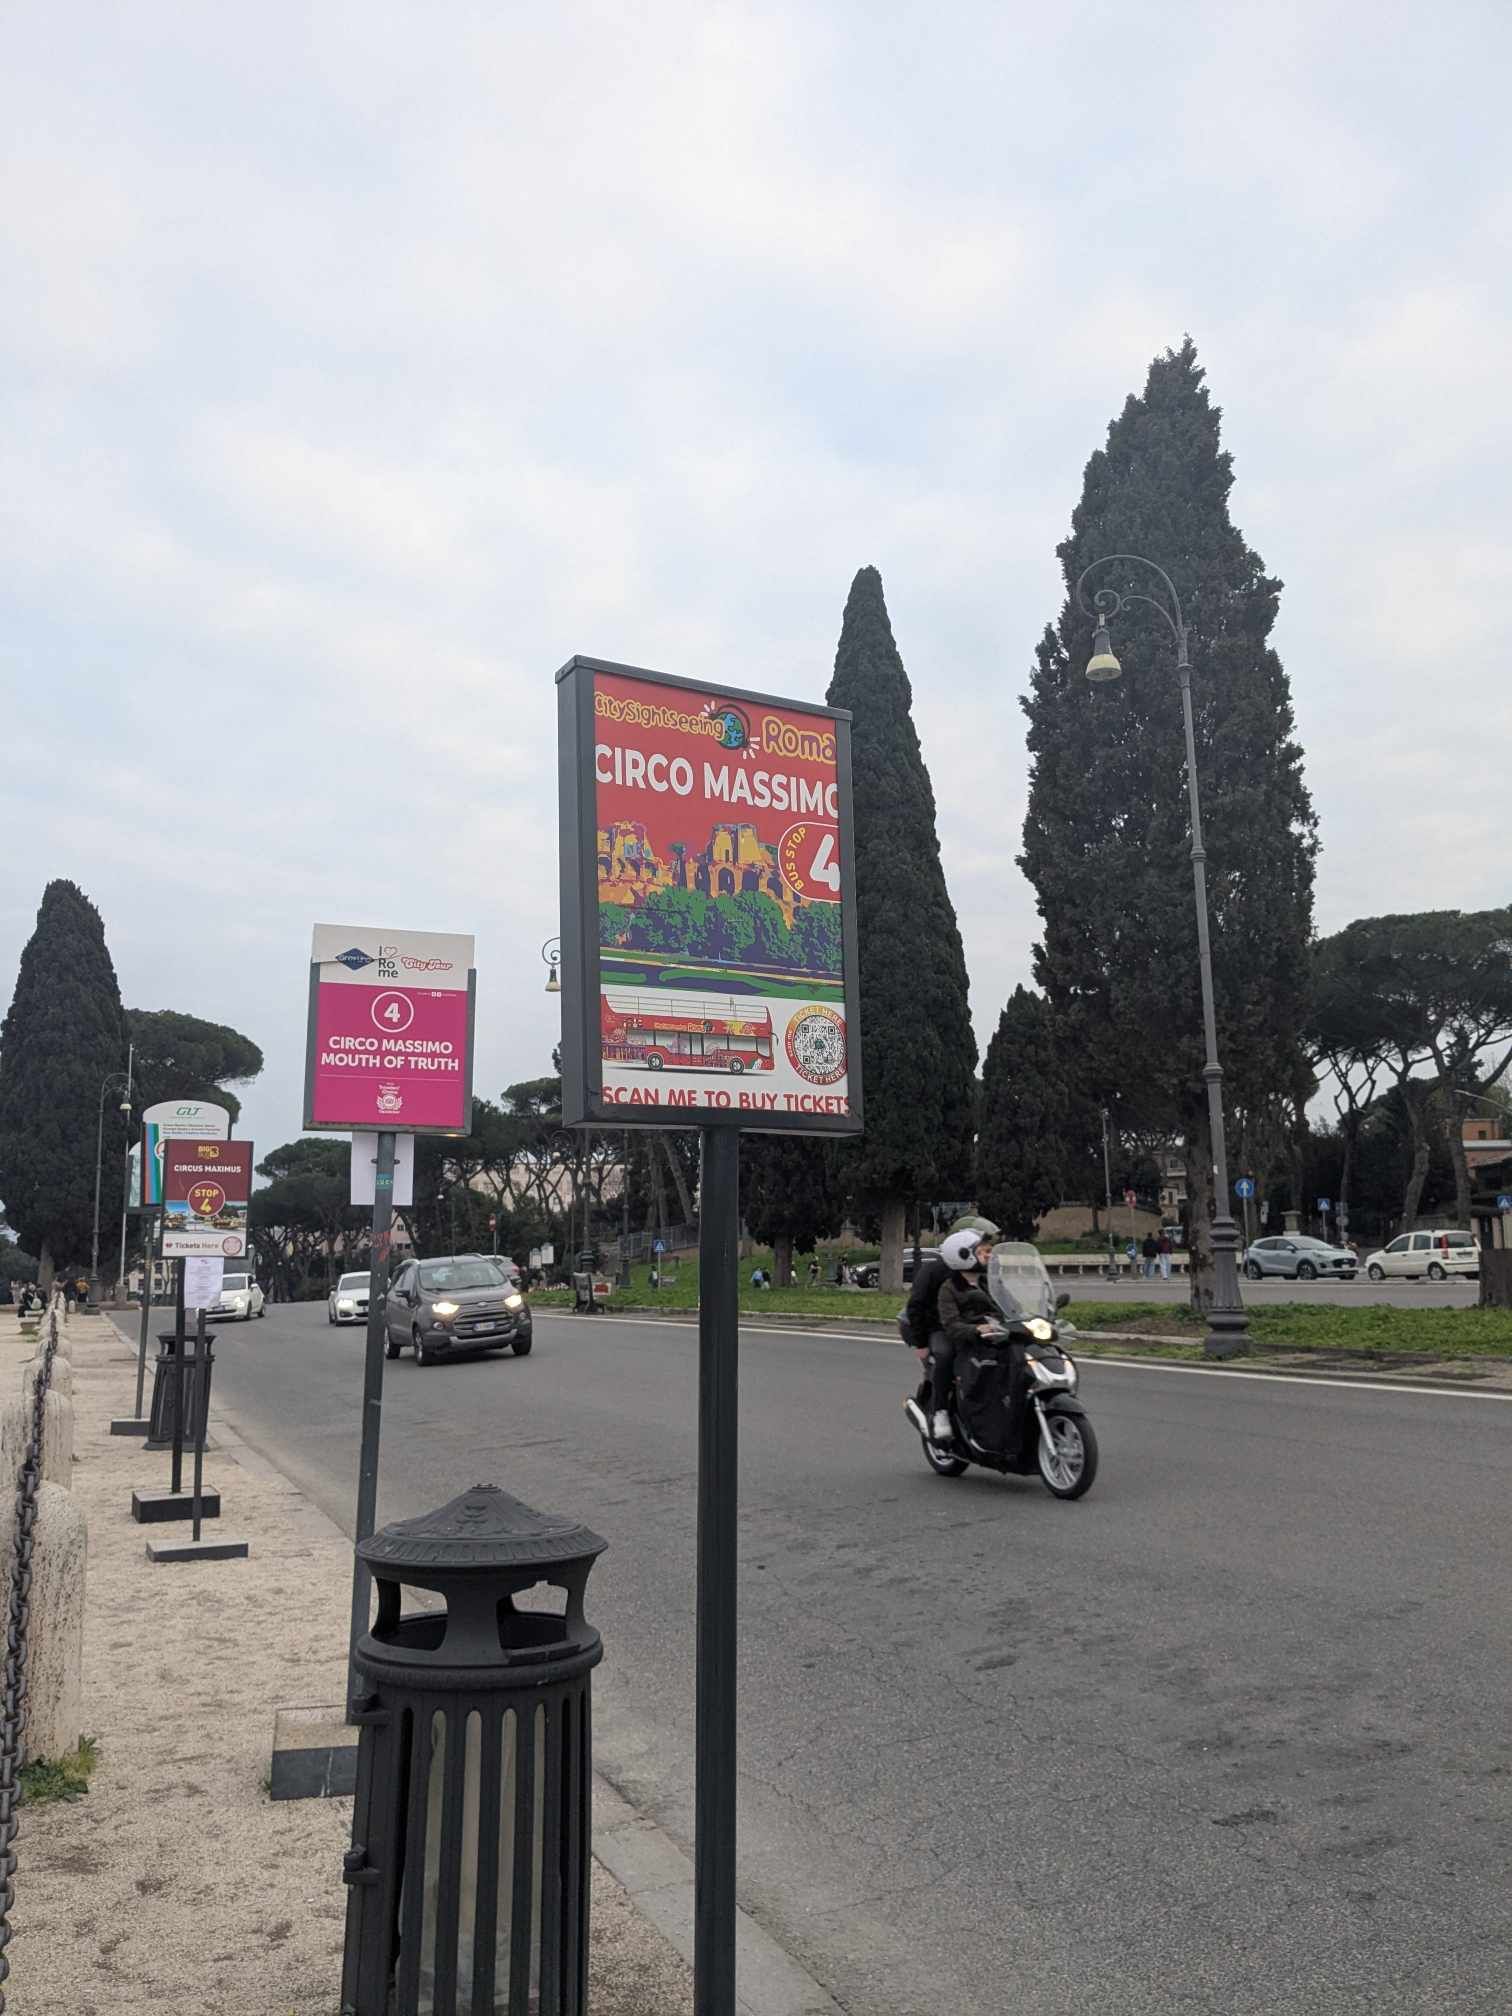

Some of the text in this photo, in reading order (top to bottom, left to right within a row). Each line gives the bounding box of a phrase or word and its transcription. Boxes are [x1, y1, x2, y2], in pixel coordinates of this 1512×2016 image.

[595, 743, 693, 796] CIRCO
[785, 827, 806, 891] BUS STOP
[809, 834, 840, 892] 4
[384, 1002, 401, 1022] 4
[329, 1036, 453, 1055] CIRCO MASSIMO
[321, 1052, 459, 1071] MOUTH OF TRUTH
[602, 1086, 660, 1105] SCAN
[668, 1088, 698, 1108] ME
[704, 1090, 731, 1110] TO
[739, 1092, 778, 1110] BUY
[173, 1164, 242, 1173] CIRCUS MAXIMUS
[194, 1188, 219, 1198] STOP
[200, 1198, 212, 1213] 4
